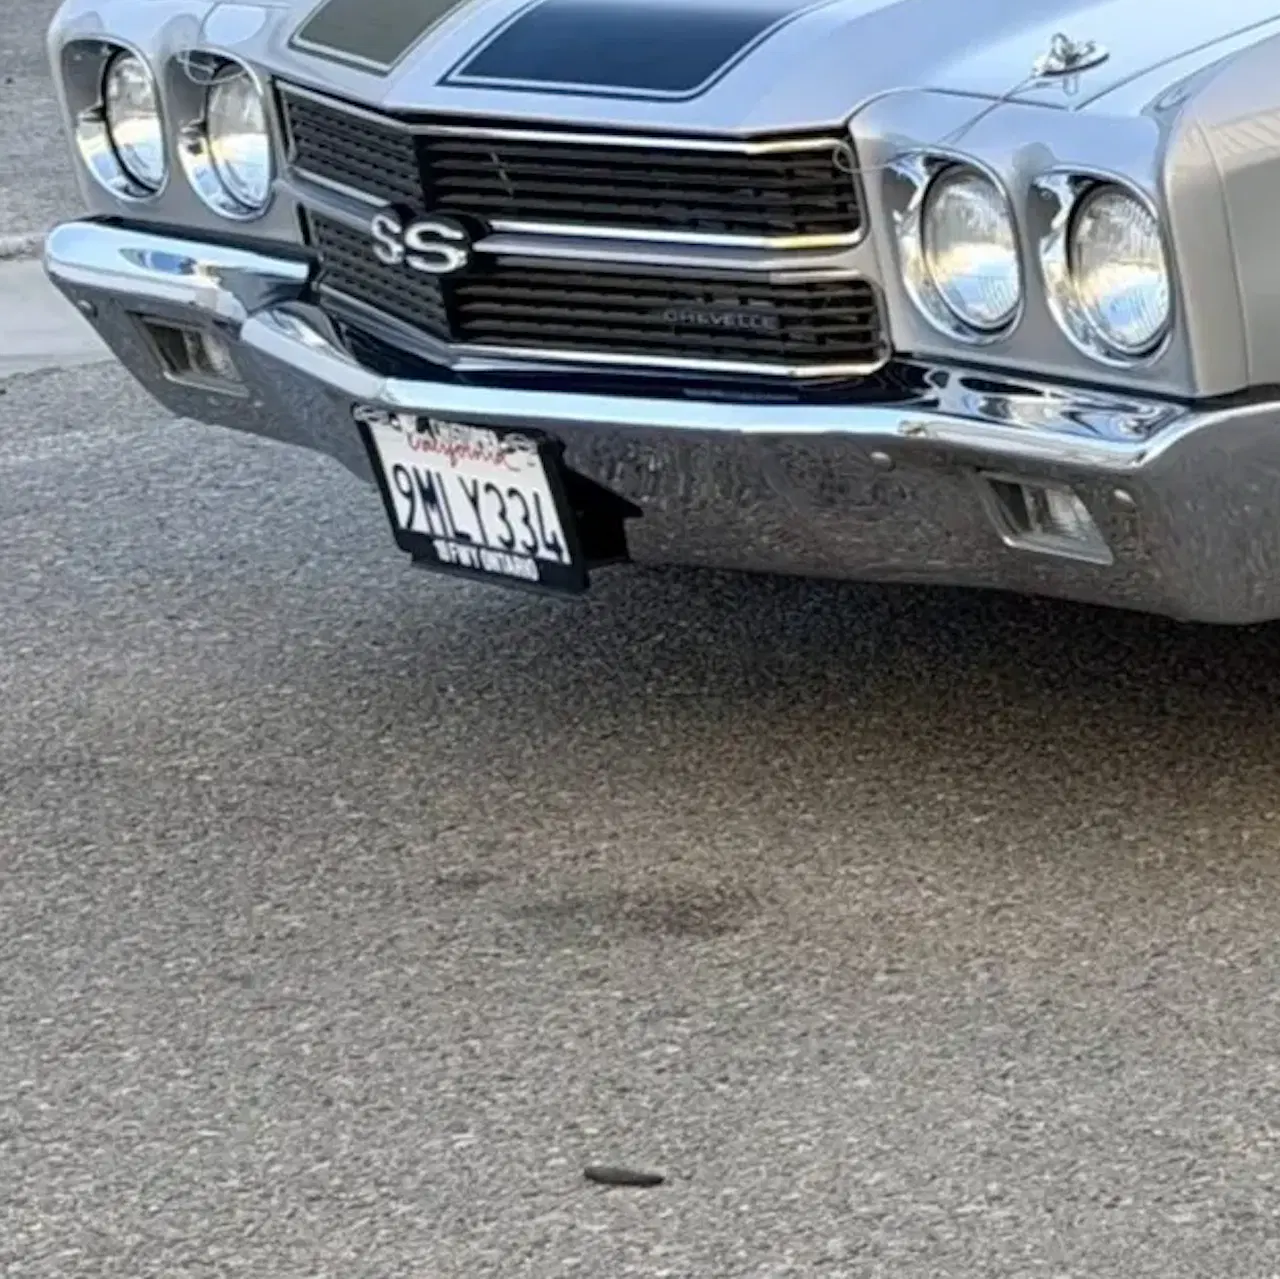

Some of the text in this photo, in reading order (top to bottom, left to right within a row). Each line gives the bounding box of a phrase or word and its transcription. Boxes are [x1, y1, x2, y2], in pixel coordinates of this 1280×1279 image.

[370, 214, 468, 273] SS
[662, 307, 779, 331] CHEVELLE
[392, 462, 565, 562] 9MLY334
